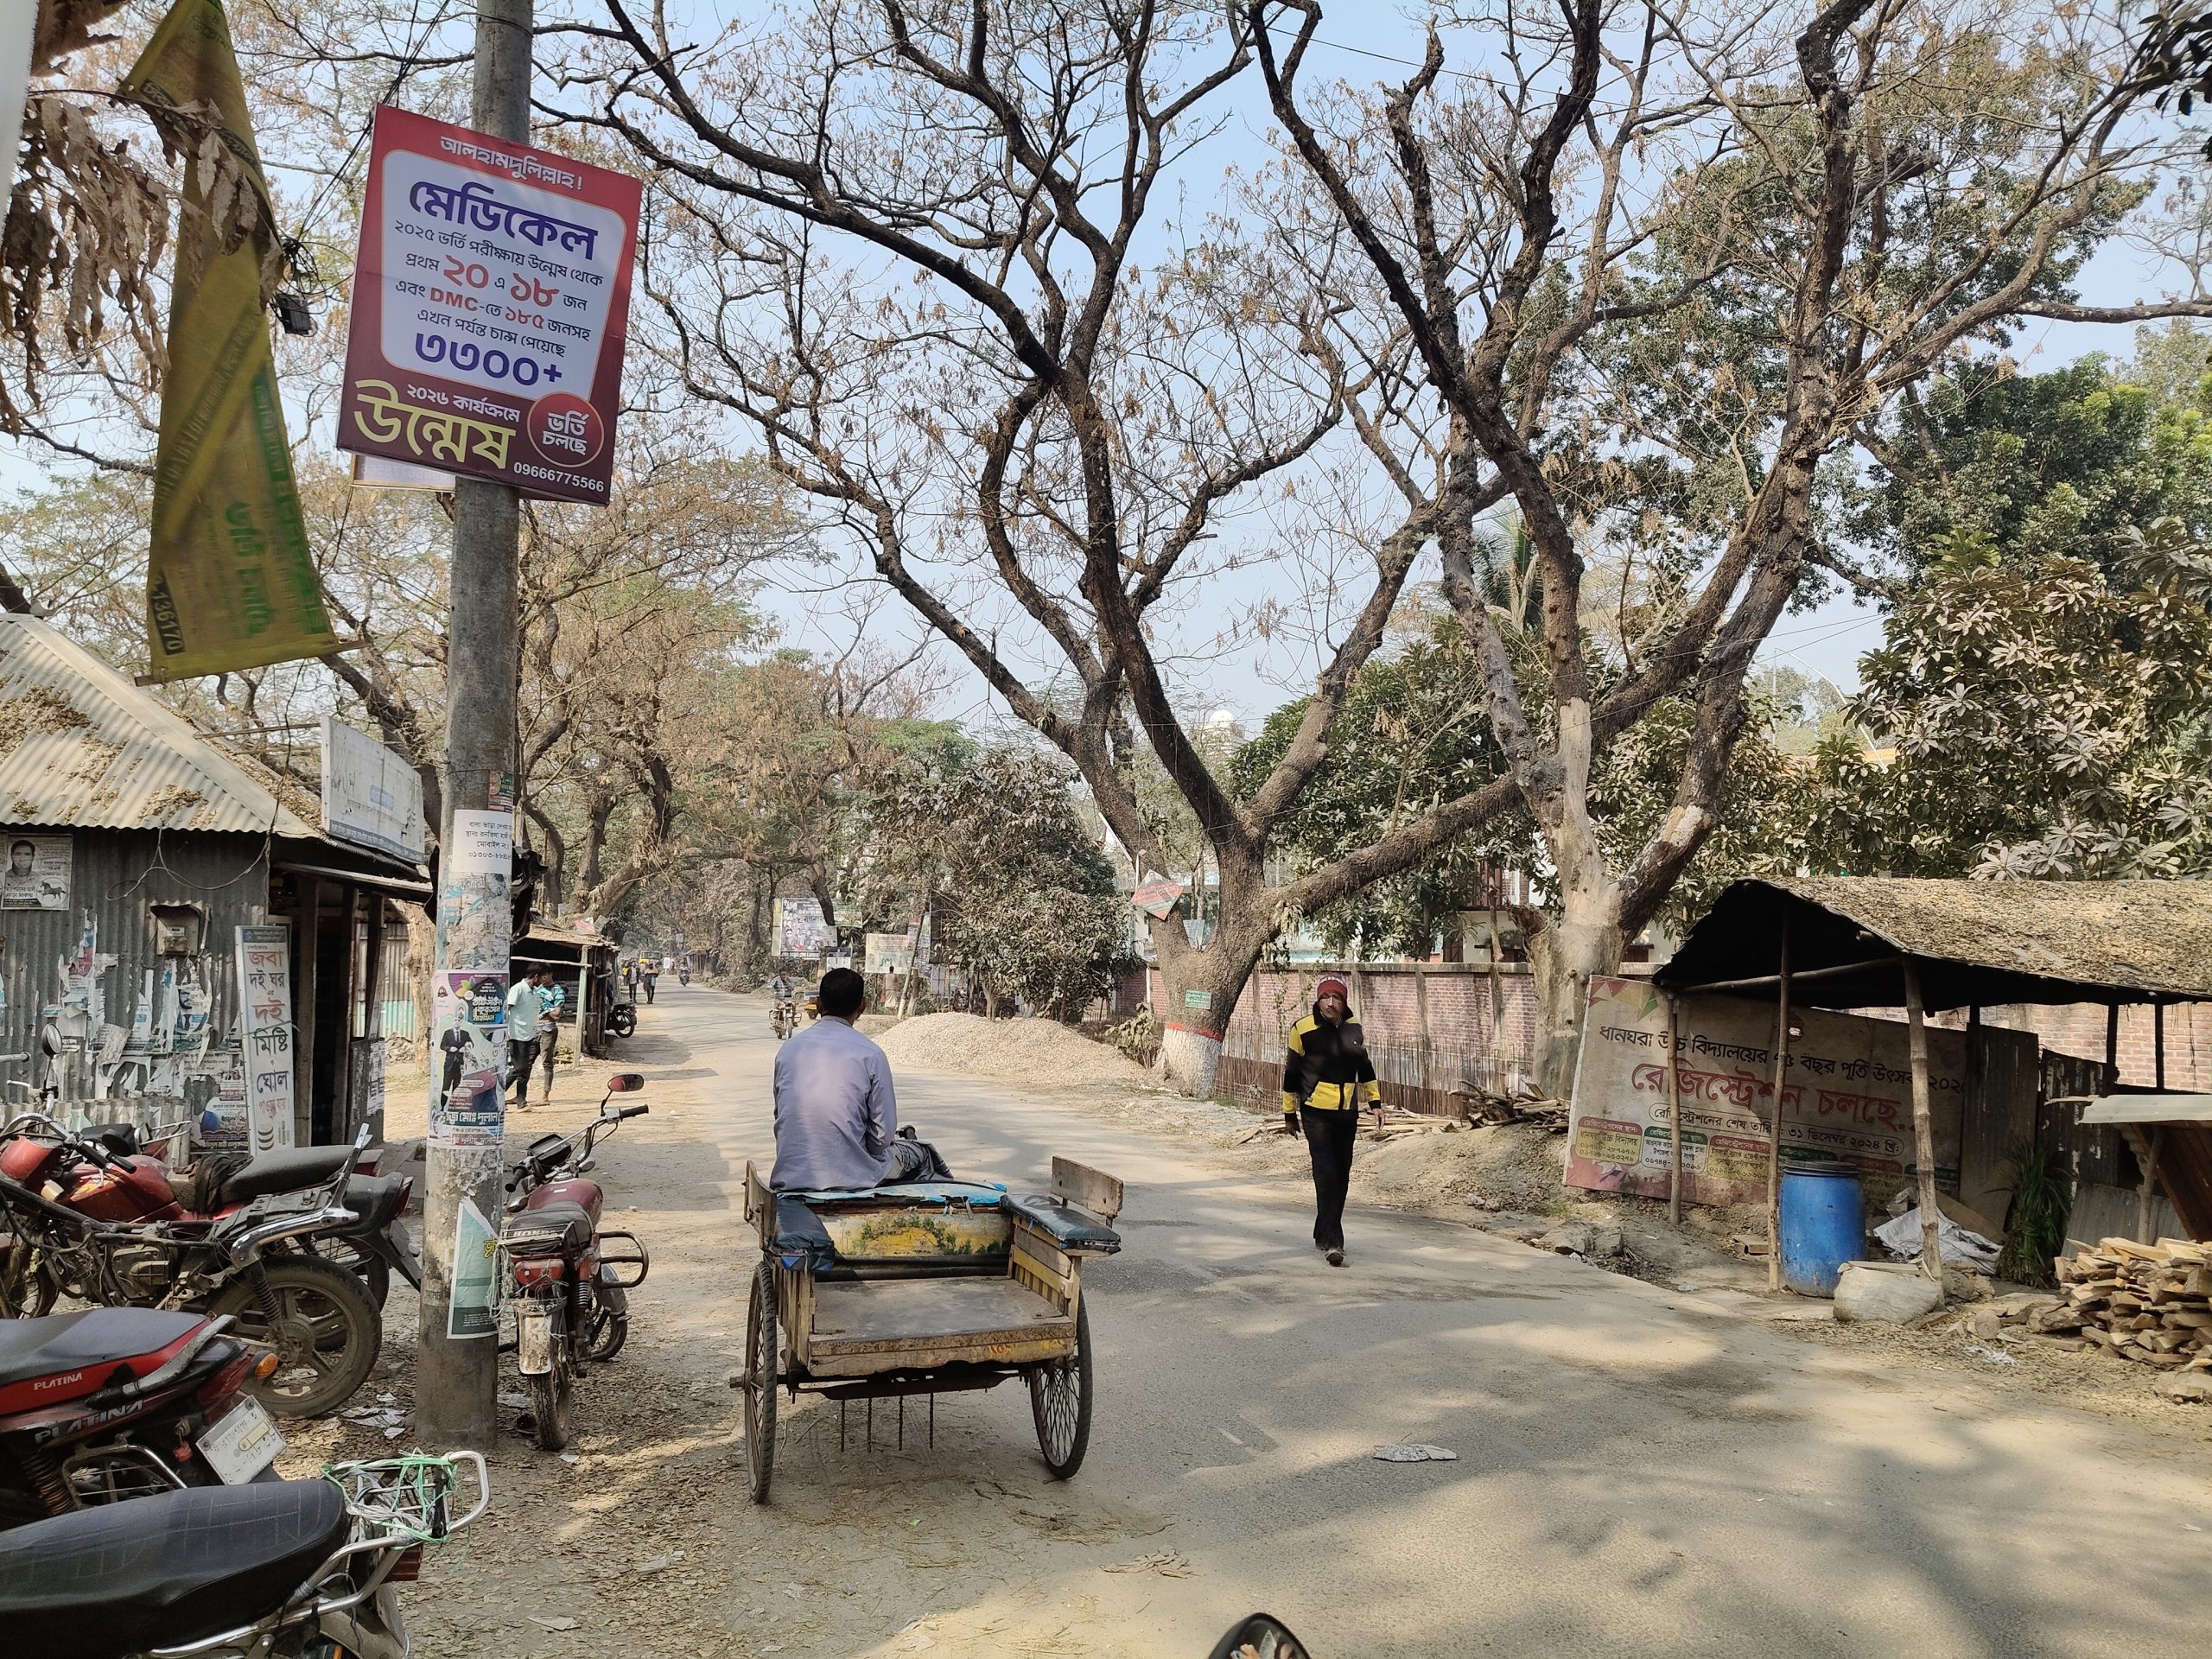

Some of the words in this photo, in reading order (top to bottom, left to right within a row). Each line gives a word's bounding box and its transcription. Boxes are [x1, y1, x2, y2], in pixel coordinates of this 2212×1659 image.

[440, 136, 583, 191] আলহামদুলিল্লাহ!
[410, 181, 599, 261] মেডিকেল
[395, 220, 435, 242] ২০২৫
[438, 231, 467, 250] ভর্তি
[469, 239, 525, 266] পরীক্ষায়
[528, 254, 568, 278] উন্মেষ
[570, 269, 605, 288] থেকে
[405, 253, 440, 271] প্রথম
[443, 254, 490, 289] ২০
[494, 276, 505, 290] এ
[511, 272, 560, 308] ১৮
[563, 294, 588, 312] জন
[396, 280, 426, 298] এবং
[505, 306, 544, 330] ১৮৫
[548, 318, 591, 342] জনসহ
[417, 308, 451, 327] এখন
[455, 319, 486, 338] পর্যন্ত
[490, 327, 518, 346] চান্স
[521, 335, 567, 359] পেয়েছে
[415, 333, 563, 386] ৩৩০০+
[406, 384, 448, 405] ২০২৬
[453, 396, 521, 423] কার্যক্রমে
[547, 410, 589, 436] ভর্তি
[354, 379, 516, 470] উন্মেষ
[542, 430, 588, 456] চলছে
[513, 461, 605, 493] 09666775566
[247, 949, 283, 968] জবা
[249, 968, 265, 991] দই
[270, 972, 285, 988] ঘর
[252, 997, 285, 1024] দই
[253, 1027, 289, 1058] মিষ্টি
[1599, 1026, 1654, 1047] ধানঘরা
[1692, 1035, 1769, 1064] বিদ্যালয়ের
[1801, 1055, 1836, 1076] বছর
[257, 1069, 289, 1095] ঘোল
[1726, 1117, 1747, 1129] শেষ
[1789, 1128, 1803, 1139] ৩১
[1808, 1128, 1846, 1146] ডিসেম্বর
[1851, 1138, 1880, 1149] ২০২৪
[34, 1371, 83, 1390] PLATINA
[35, 1398, 144, 1445] PLATINA
